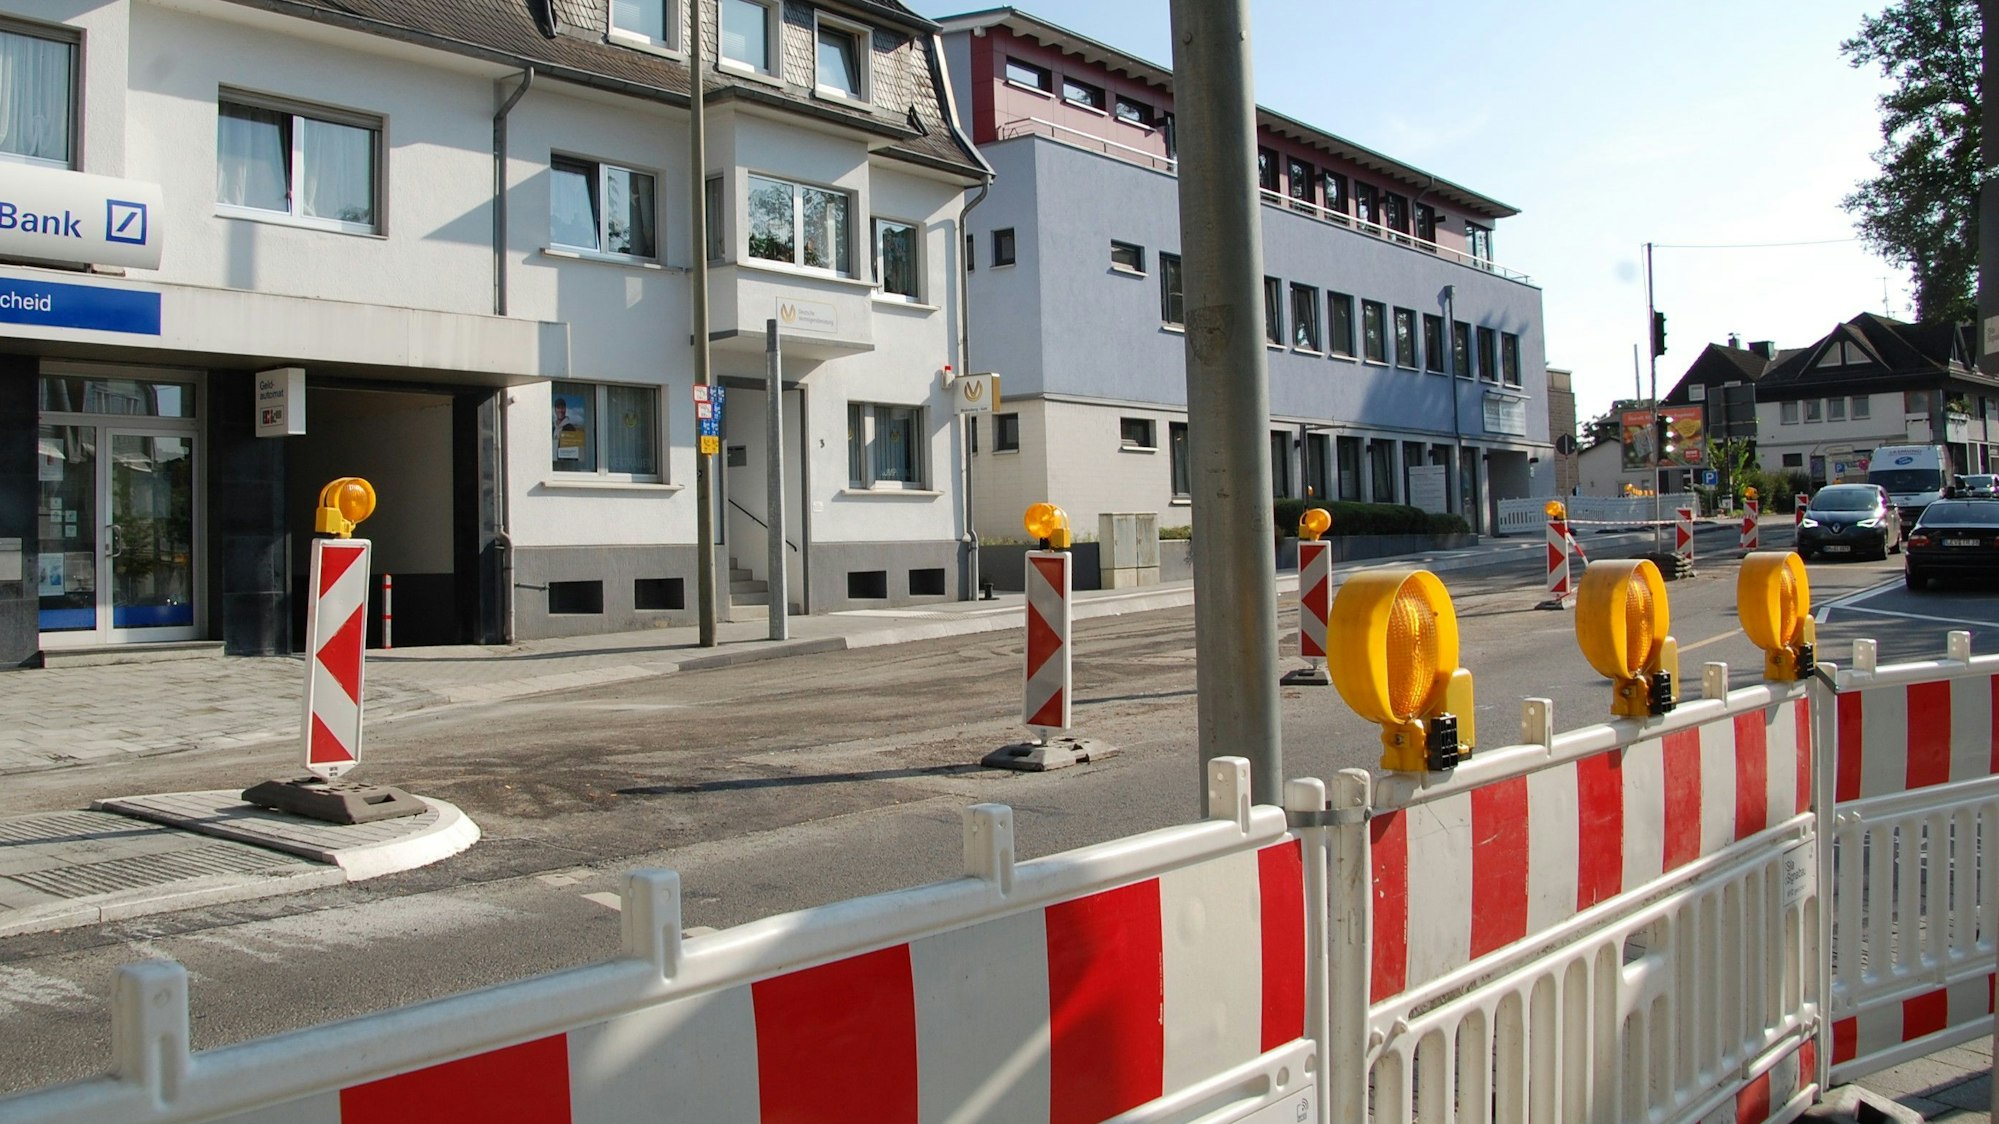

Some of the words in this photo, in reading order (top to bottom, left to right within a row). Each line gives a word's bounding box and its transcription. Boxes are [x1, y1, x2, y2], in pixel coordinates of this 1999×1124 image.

[0, 201, 82, 239] Bank
[260, 388, 284, 400] automat
[1705, 472, 1714, 482] P
